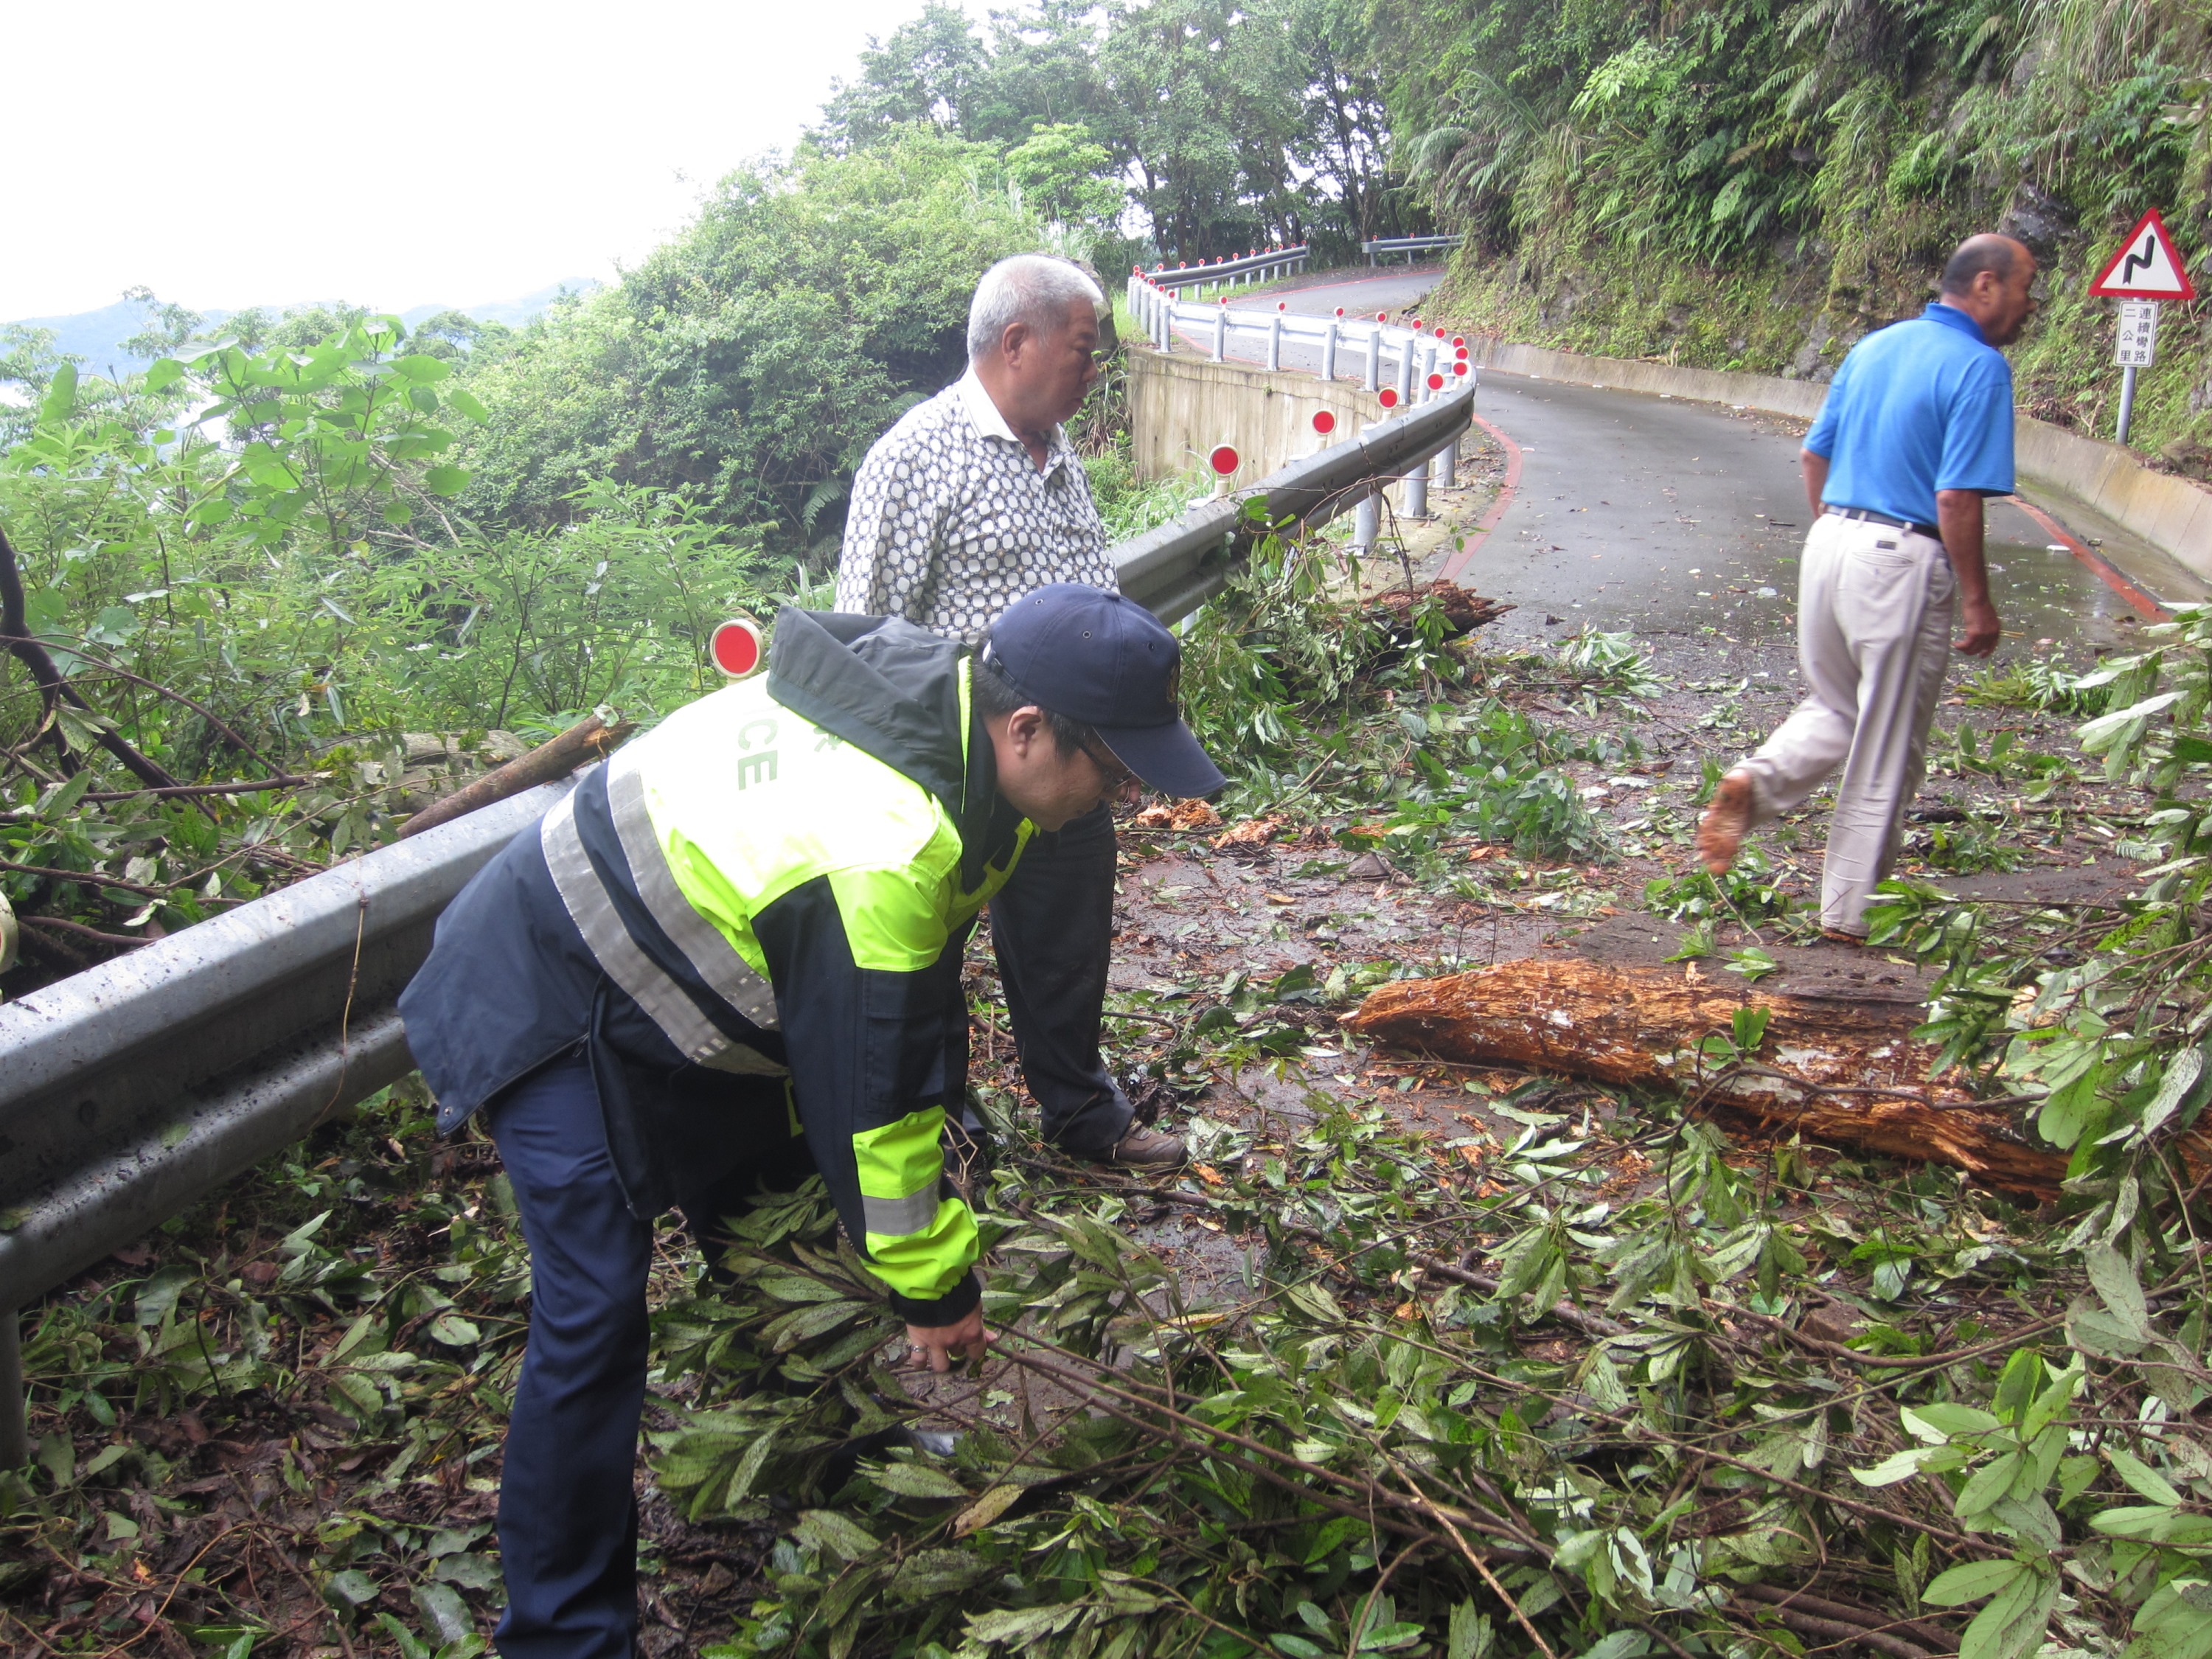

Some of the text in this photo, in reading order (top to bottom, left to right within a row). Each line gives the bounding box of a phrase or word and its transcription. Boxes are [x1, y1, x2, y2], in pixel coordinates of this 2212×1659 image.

[2120, 308, 2136, 361] 二公里
[2134, 307, 2152, 362] 連續彎路
